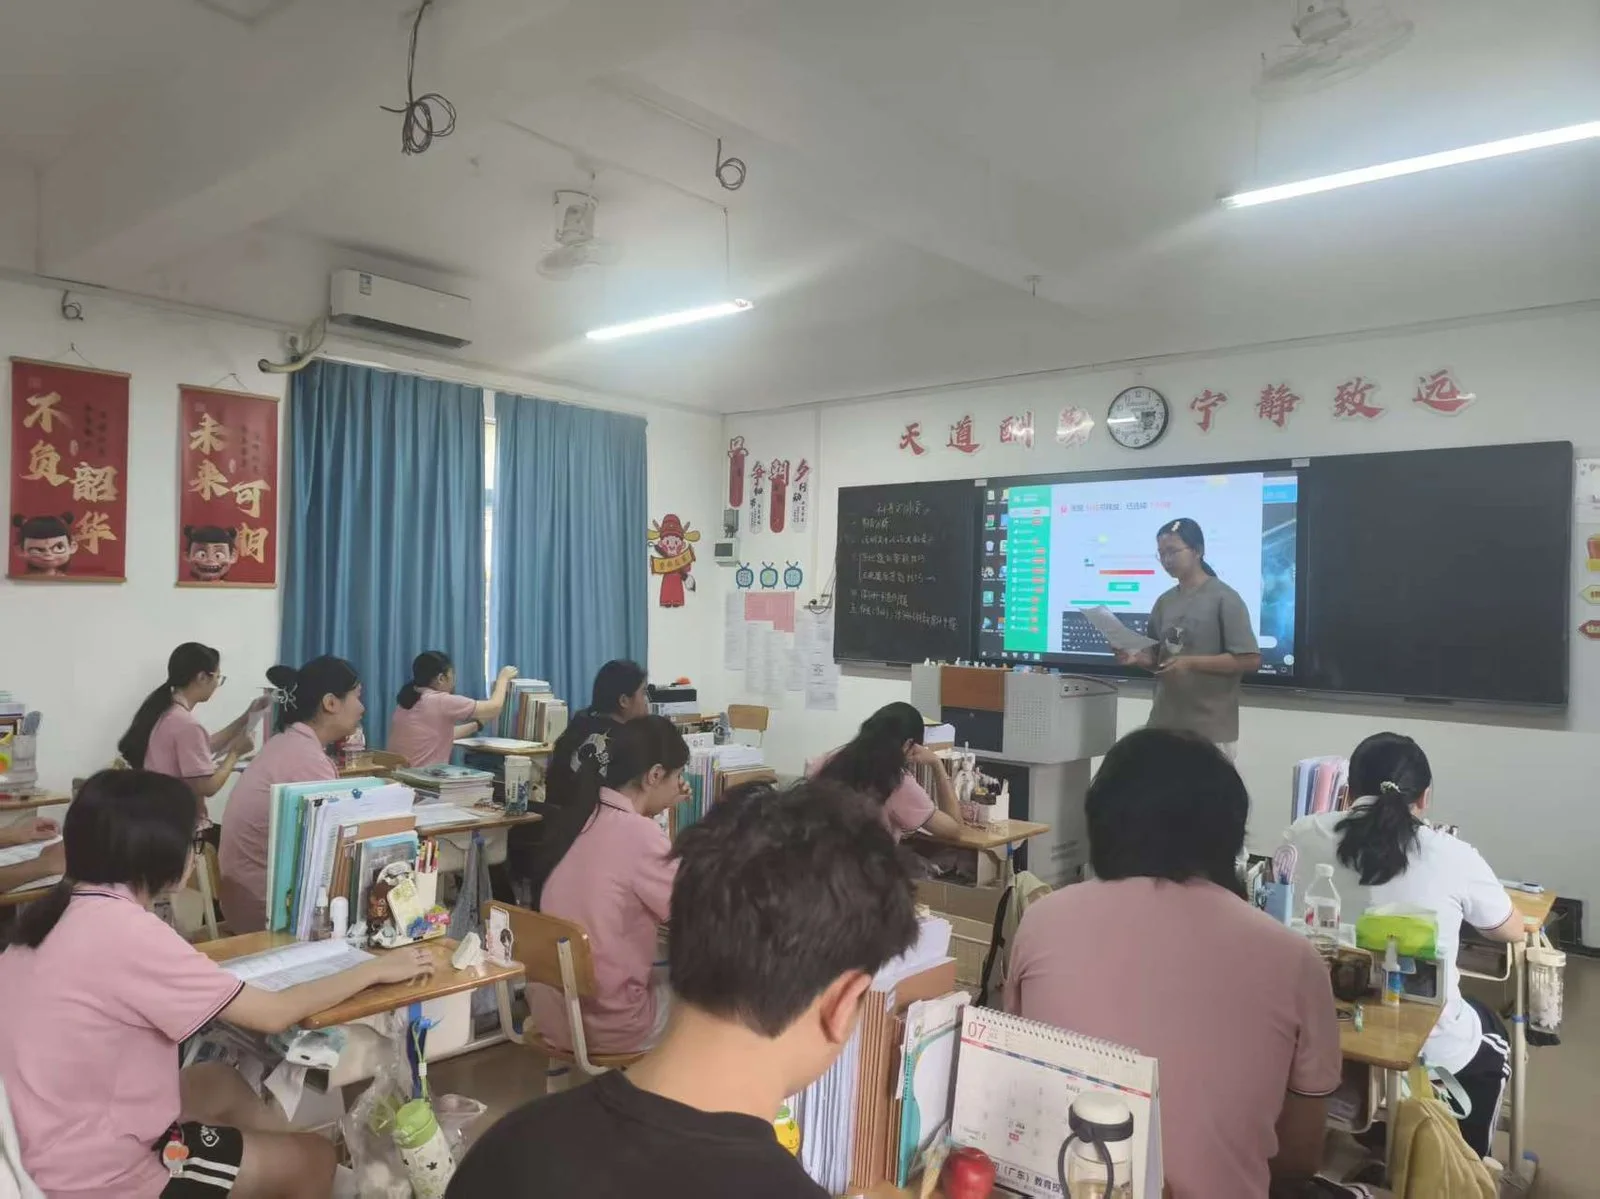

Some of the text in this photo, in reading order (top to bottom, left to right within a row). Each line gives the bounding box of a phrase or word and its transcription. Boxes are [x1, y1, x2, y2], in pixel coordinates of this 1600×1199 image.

[1191, 369, 1475, 432] 宁静致远
[968, 1021, 986, 1040] 07
